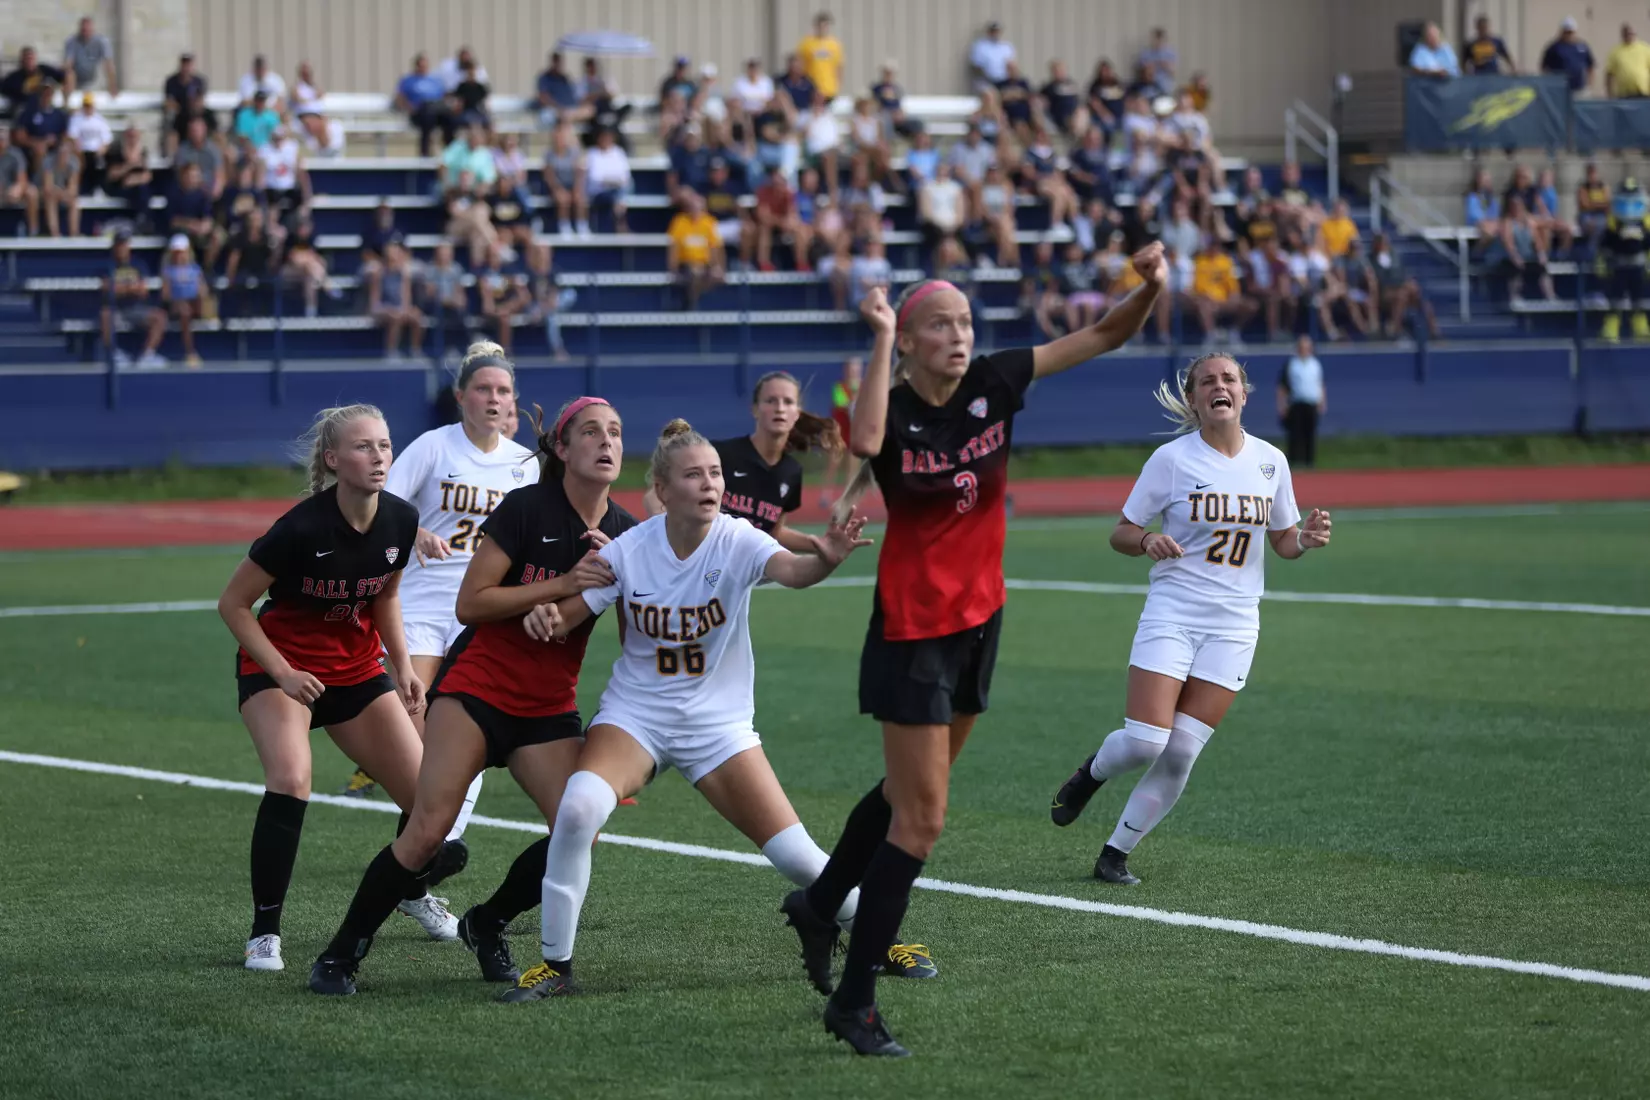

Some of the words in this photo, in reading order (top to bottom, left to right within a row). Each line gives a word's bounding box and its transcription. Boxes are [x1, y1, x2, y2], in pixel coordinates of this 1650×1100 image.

[902, 449, 955, 473] BALL
[440, 481, 508, 515] TOLE
[953, 470, 978, 514] 3
[1204, 529, 1252, 569] 20
[302, 577, 349, 598] BALL
[628, 597, 726, 643] TOLEDO
